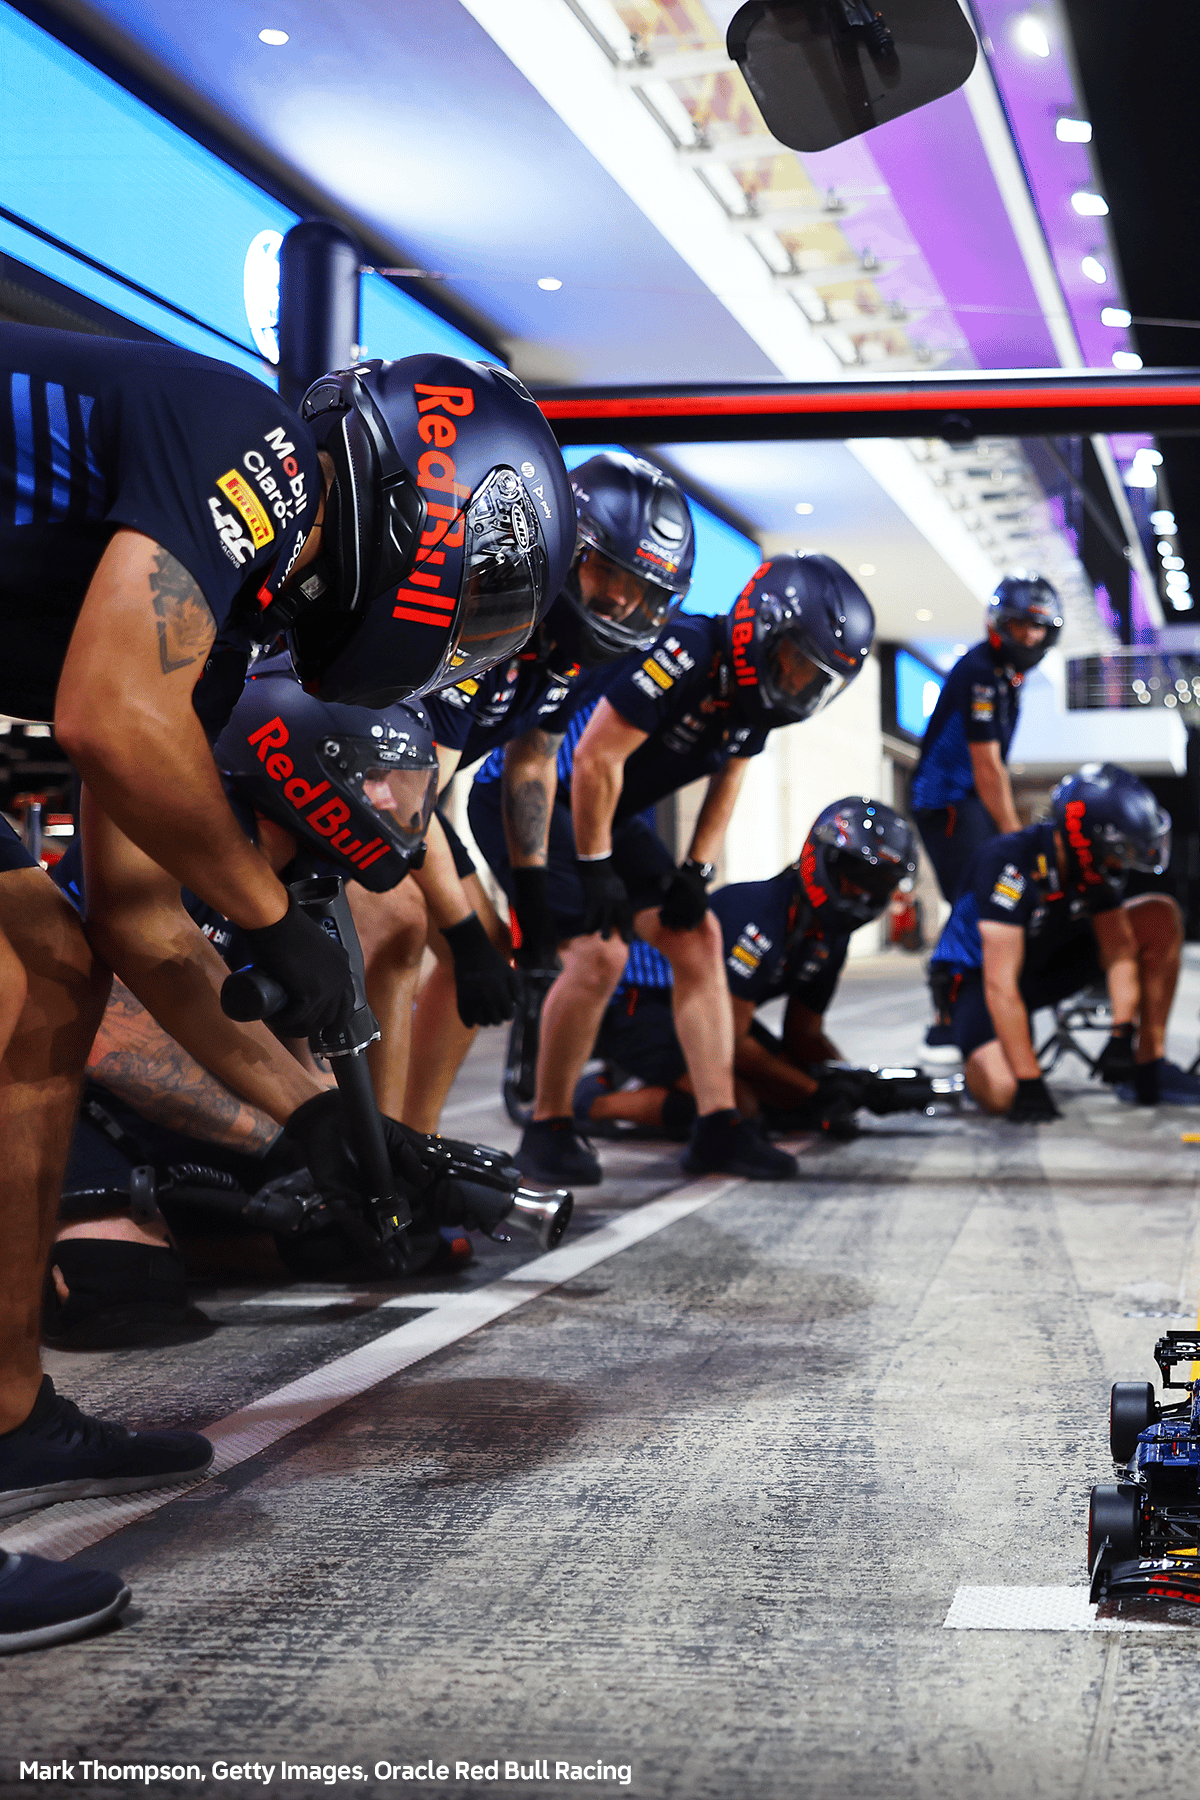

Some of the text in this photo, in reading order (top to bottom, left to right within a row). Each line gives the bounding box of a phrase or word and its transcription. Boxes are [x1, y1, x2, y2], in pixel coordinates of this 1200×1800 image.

[243, 451, 287, 520] Claro
[264, 426, 307, 515] Mobil
[414, 383, 475, 500] Red
[540, 501, 552, 518] poly
[392, 502, 466, 628] Bull
[247, 716, 391, 871] Red Bull
